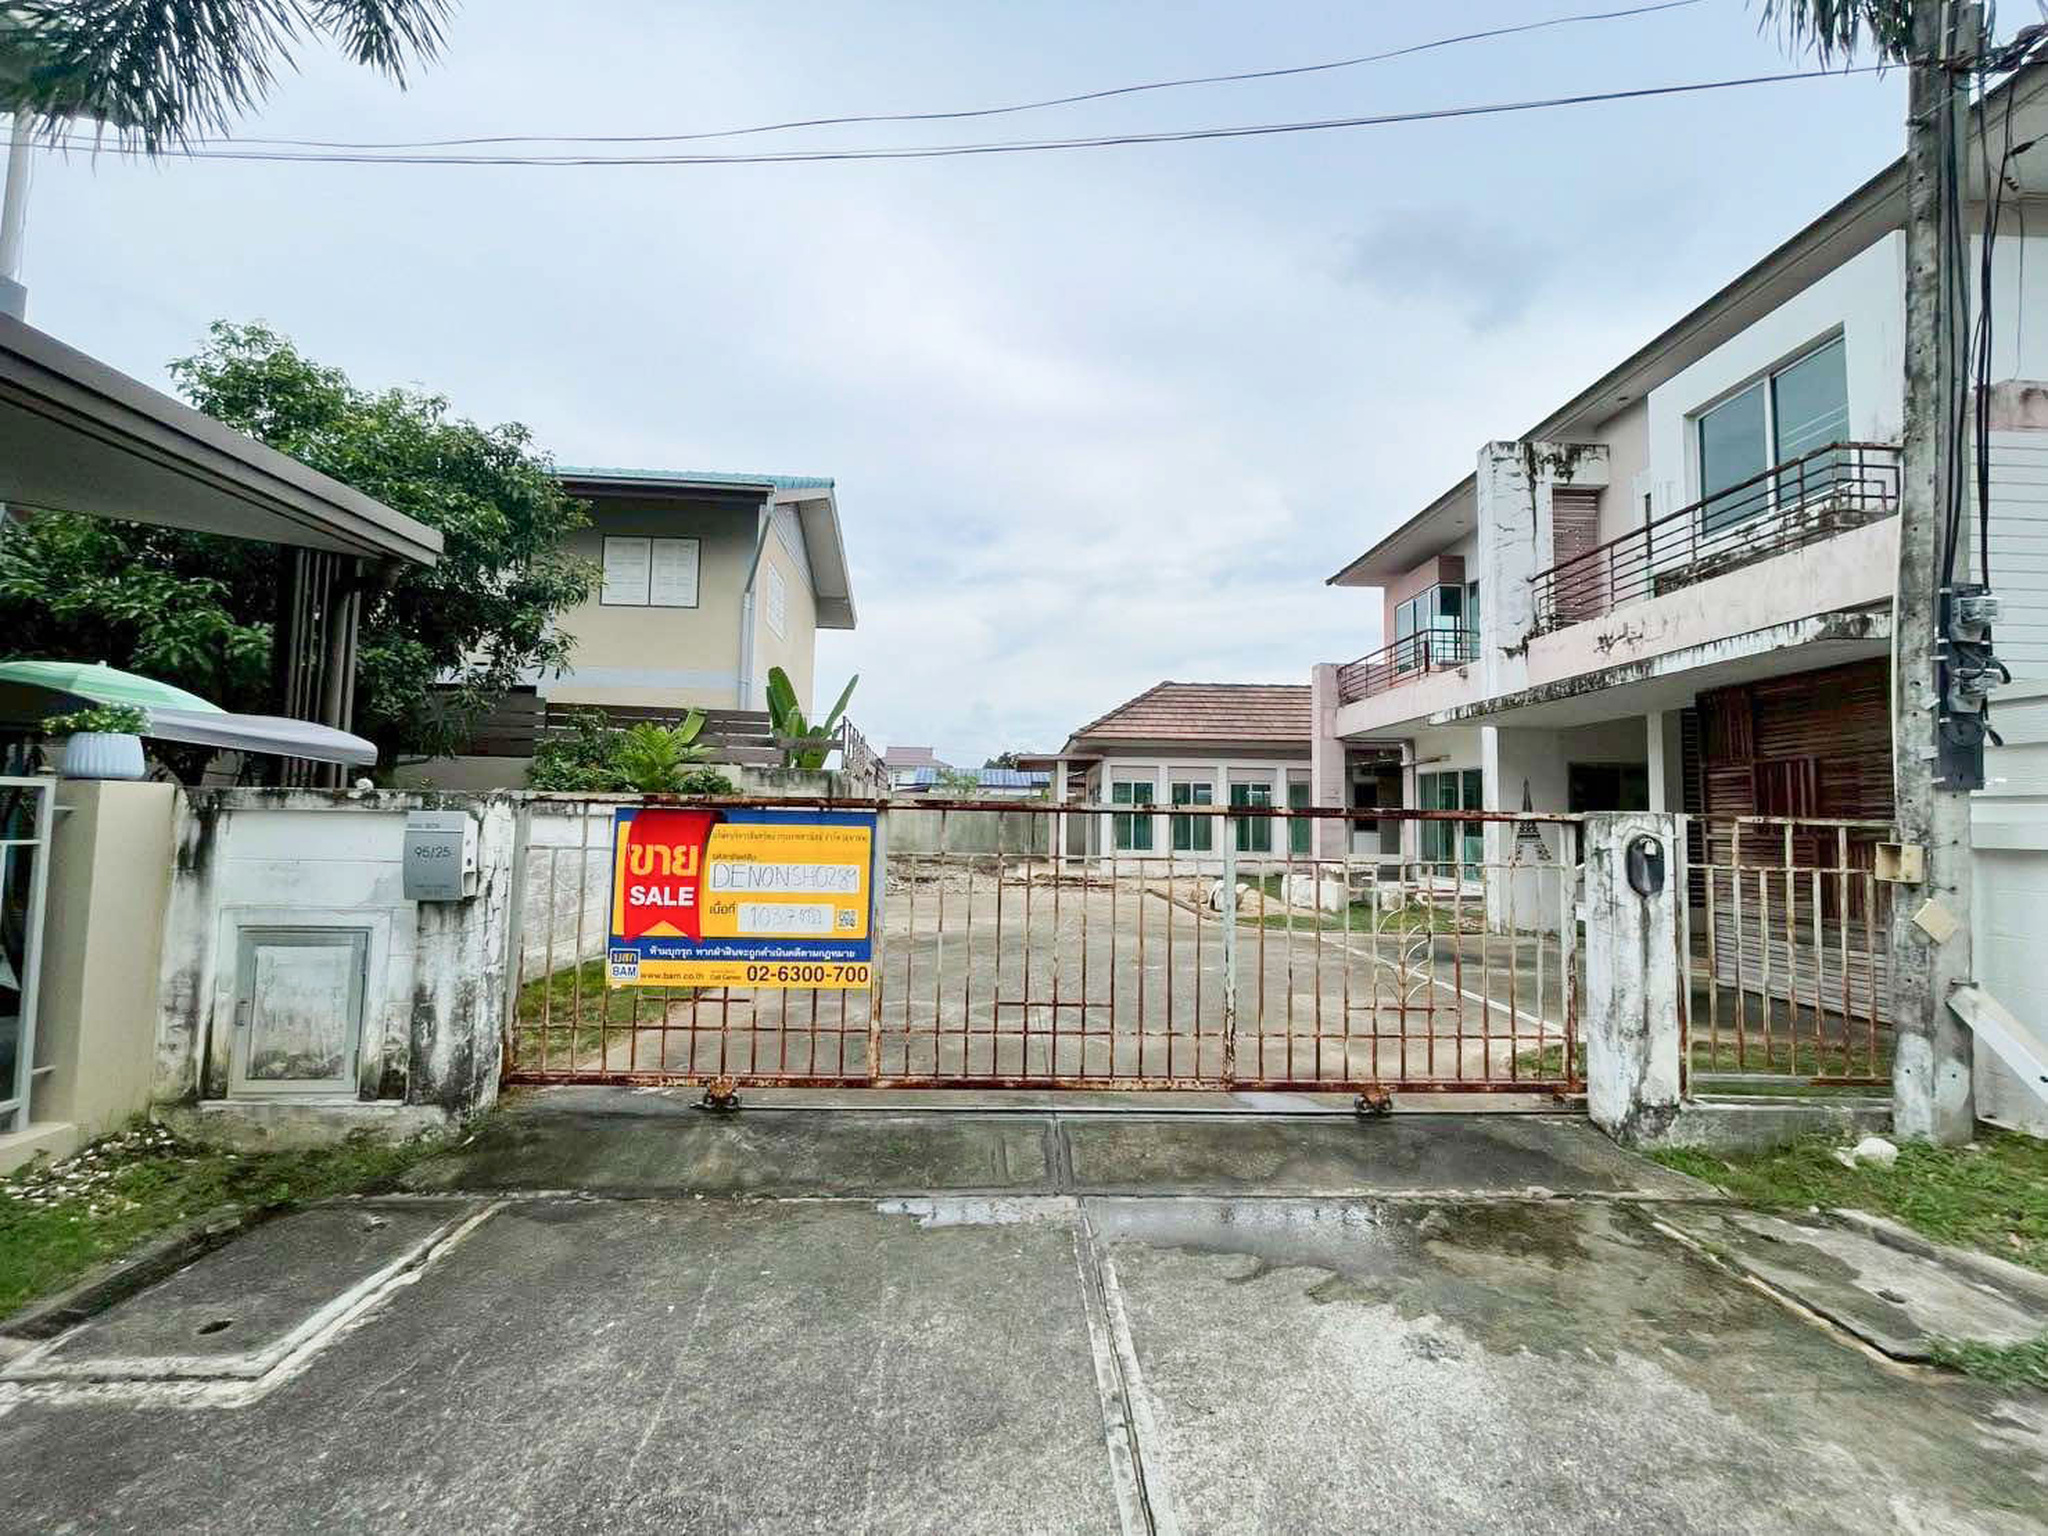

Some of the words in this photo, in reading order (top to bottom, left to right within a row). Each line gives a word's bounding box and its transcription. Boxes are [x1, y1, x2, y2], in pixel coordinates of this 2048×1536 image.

[414, 846, 452, 859] 95/25
[630, 844, 699, 876] ขาย
[630, 885, 695, 907] SALE
[612, 966, 637, 977] BAM
[640, 972, 705, 980] www.bam.co.th
[747, 965, 868, 982] 02-6300-700
